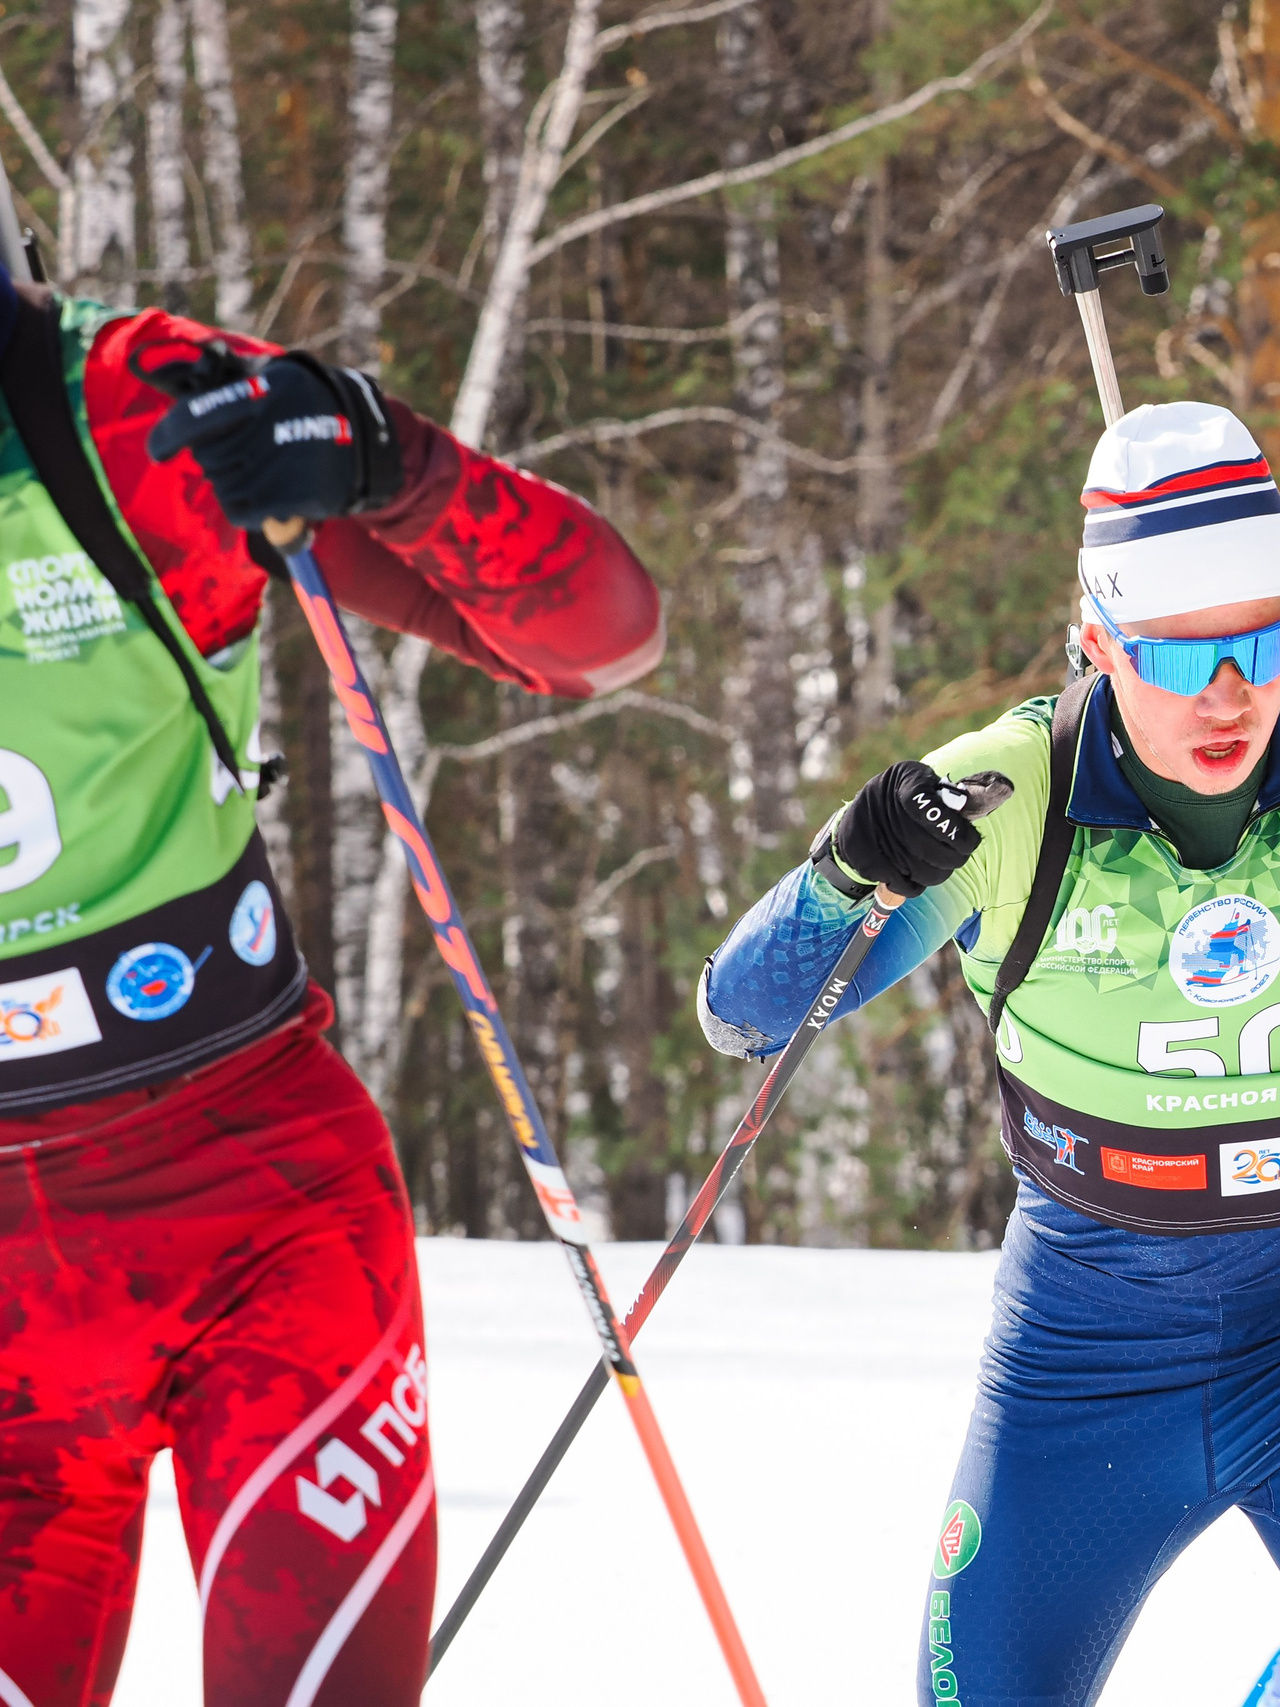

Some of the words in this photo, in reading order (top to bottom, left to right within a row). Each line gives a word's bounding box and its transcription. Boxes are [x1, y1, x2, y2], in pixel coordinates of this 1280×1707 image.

[912, 792, 960, 841] MOAX
[1103, 918, 1119, 927] ЛЕТ
[1178, 898, 1232, 937] ПЕРВЕНСТВО
[1040, 955, 1103, 966] МИНИСТЕРСТВО
[1103, 958, 1136, 967] СПОРТА
[1035, 961, 1087, 974] РОССИЙСКОЙ
[1087, 965, 1139, 976] ФЕДЕРАЦИИ
[806, 977, 849, 1030] MOAX
[1193, 993, 1247, 1004] Красноярск
[1131, 1156, 1200, 1168] КРАСНОЯРСКИЙ
[1131, 1163, 1154, 1172] КРАЙ
[928, 1590, 961, 1707] БЕЛО
